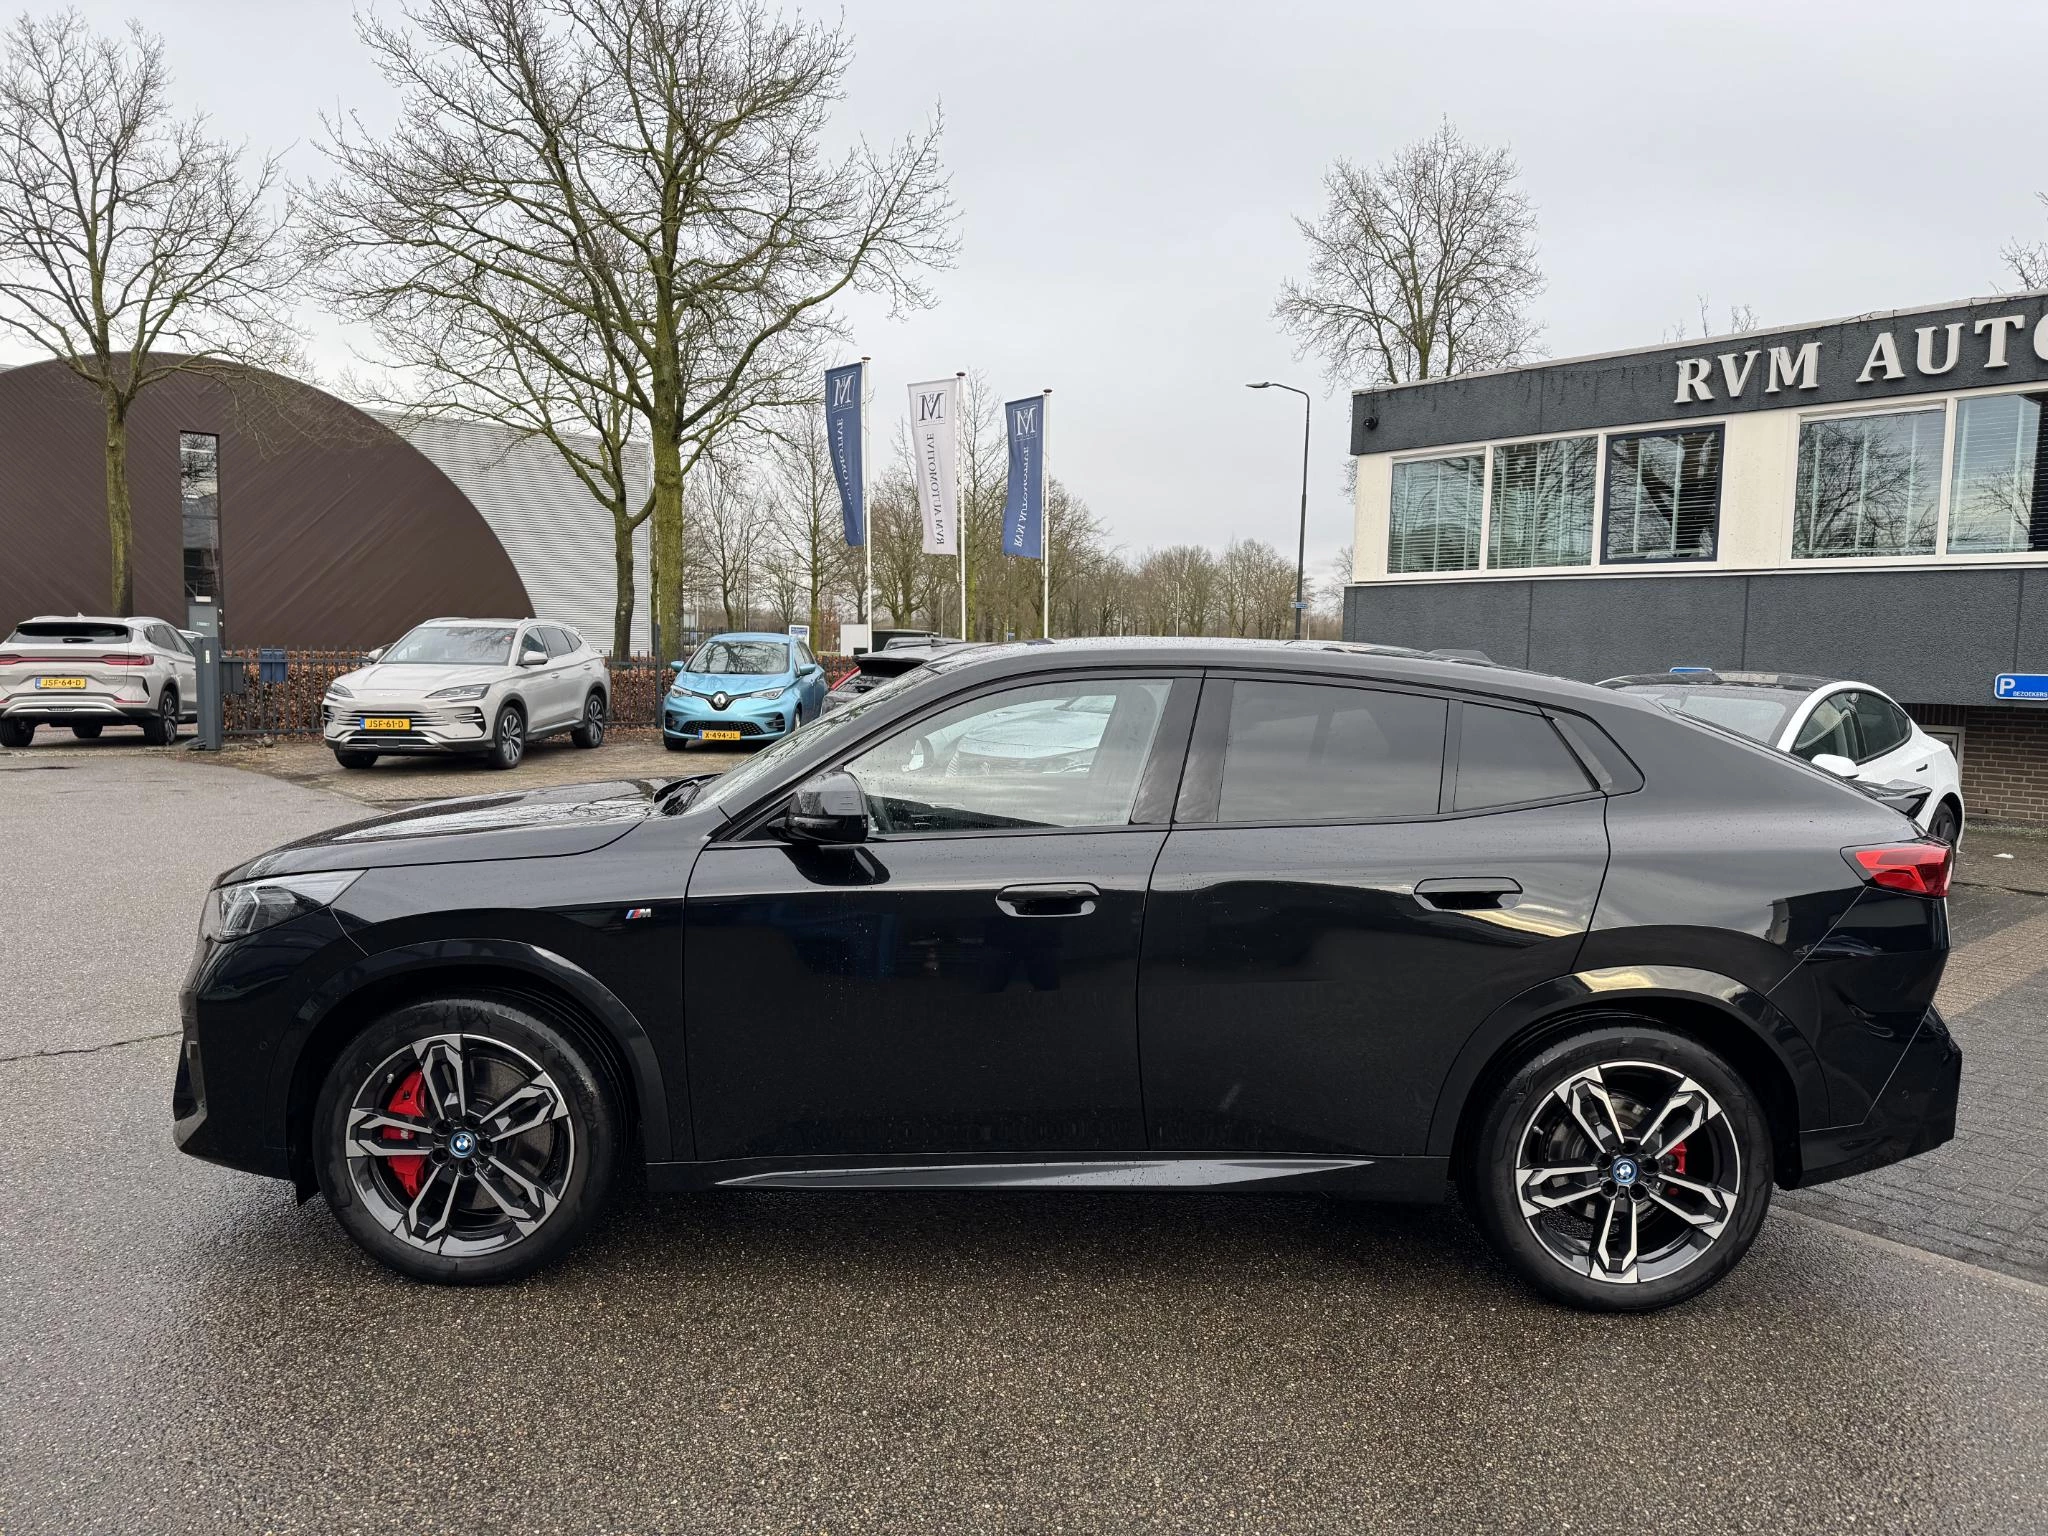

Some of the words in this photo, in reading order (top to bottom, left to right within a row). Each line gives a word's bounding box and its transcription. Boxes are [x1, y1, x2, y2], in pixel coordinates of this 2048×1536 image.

[1673, 342, 1823, 404] RVM
[42, 679, 82, 687] JSF-64-D
[1999, 677, 2016, 695] P
[368, 720, 404, 728] JSF-61-D
